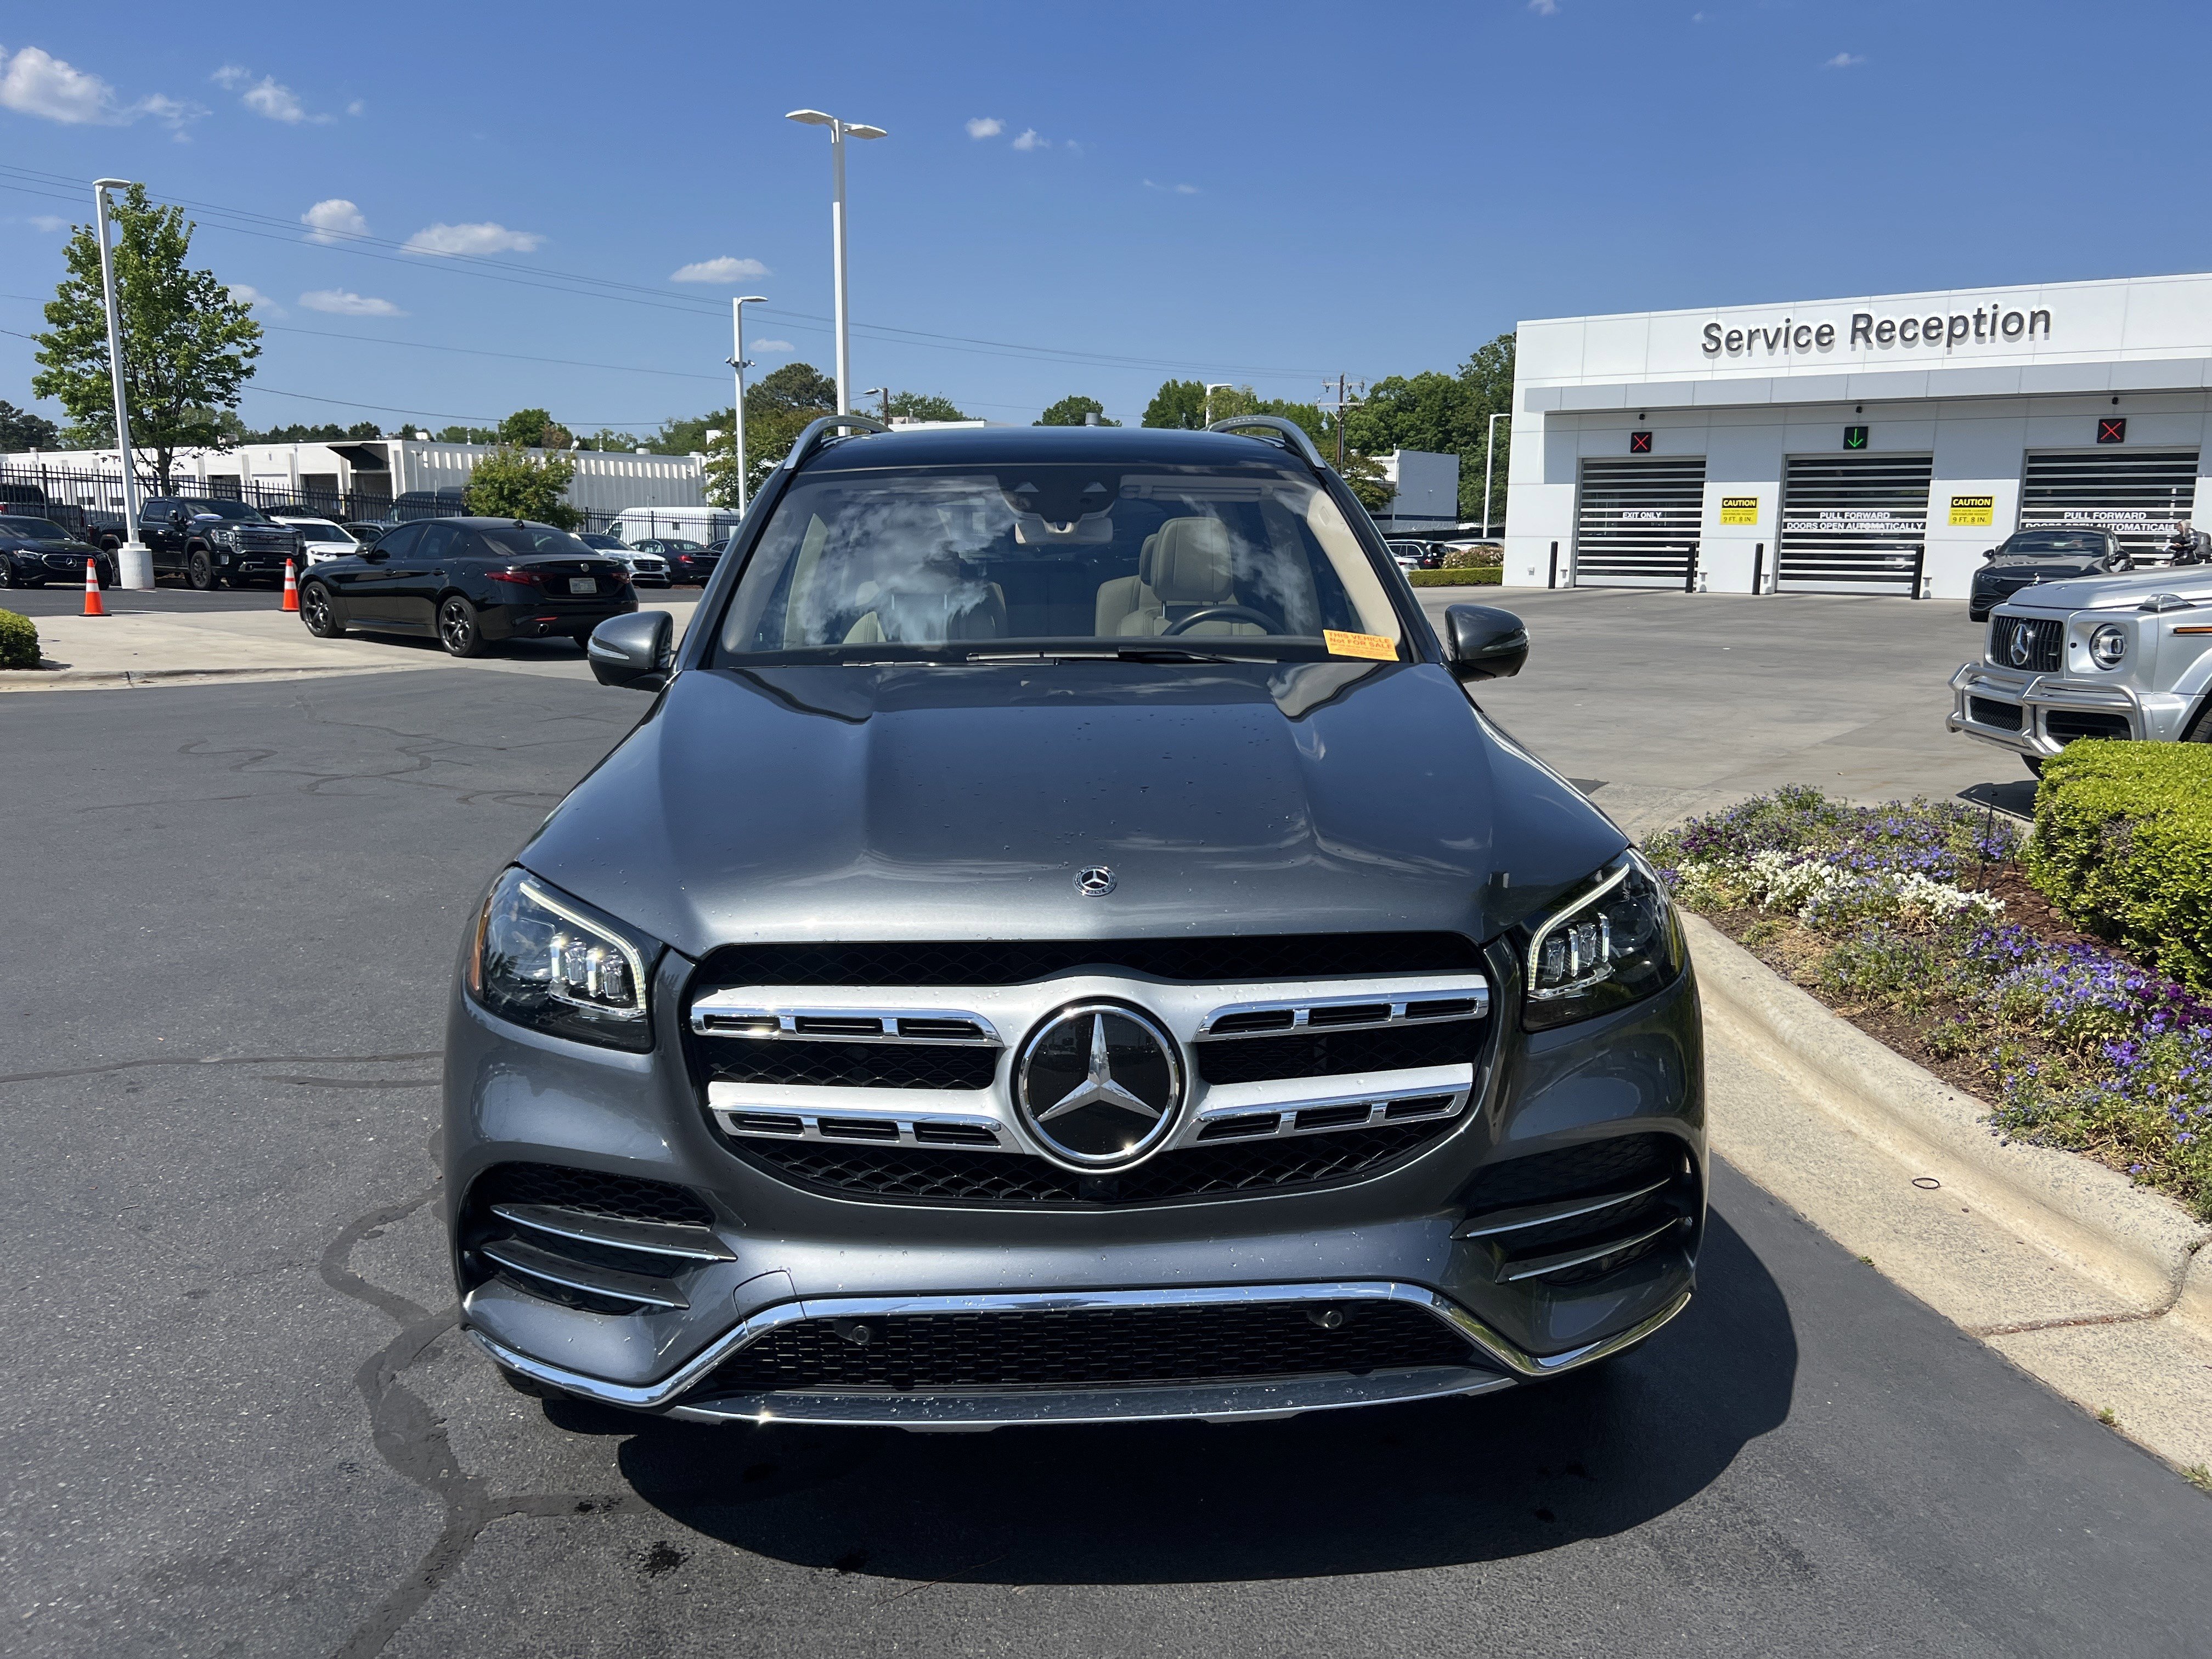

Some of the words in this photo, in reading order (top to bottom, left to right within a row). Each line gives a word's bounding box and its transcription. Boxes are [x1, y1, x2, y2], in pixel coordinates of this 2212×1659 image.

[1701, 318, 1835, 353] Service
[1850, 303, 2051, 348] Reception
[2097, 523, 2178, 531] UTOMATICALL
[1351, 634, 1390, 644] VEHICLE
